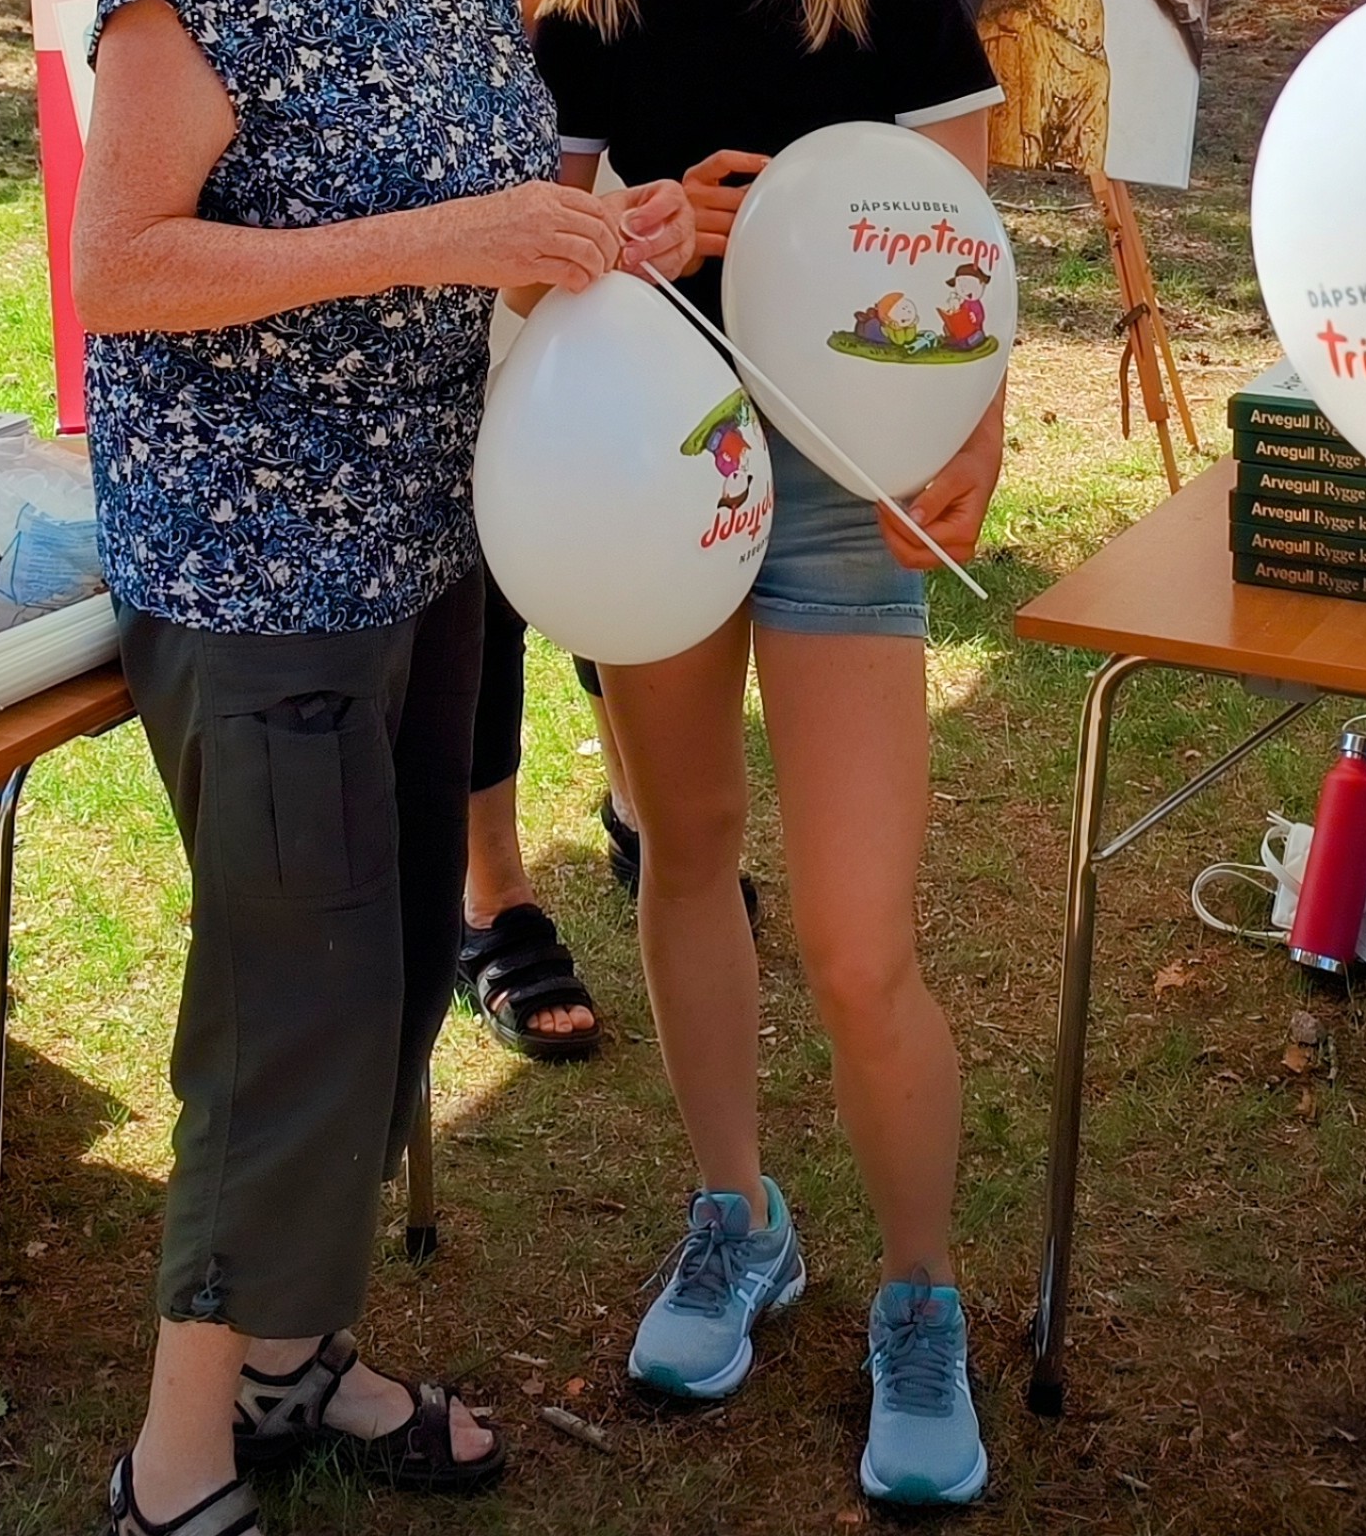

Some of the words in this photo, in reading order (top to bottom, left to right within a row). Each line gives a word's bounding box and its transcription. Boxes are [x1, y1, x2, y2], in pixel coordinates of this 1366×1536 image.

[849, 199, 960, 216] DÅPSKLUBBEN
[1251, 409, 1310, 429] Arvegull
[1314, 416, 1339, 437] Ryg
[1256, 441, 1314, 461] Arvegull
[1319, 449, 1362, 470] Rygge
[1260, 474, 1320, 494] Arvegull
[1323, 481, 1366, 503] Rygge
[1251, 502, 1310, 523] Arvegull
[1314, 510, 1355, 532] Rygge
[1251, 534, 1310, 555] Arvegull
[1314, 541, 1356, 564] Rygge
[1255, 563, 1315, 585] Arvegull
[1317, 570, 1360, 593] Rygge
